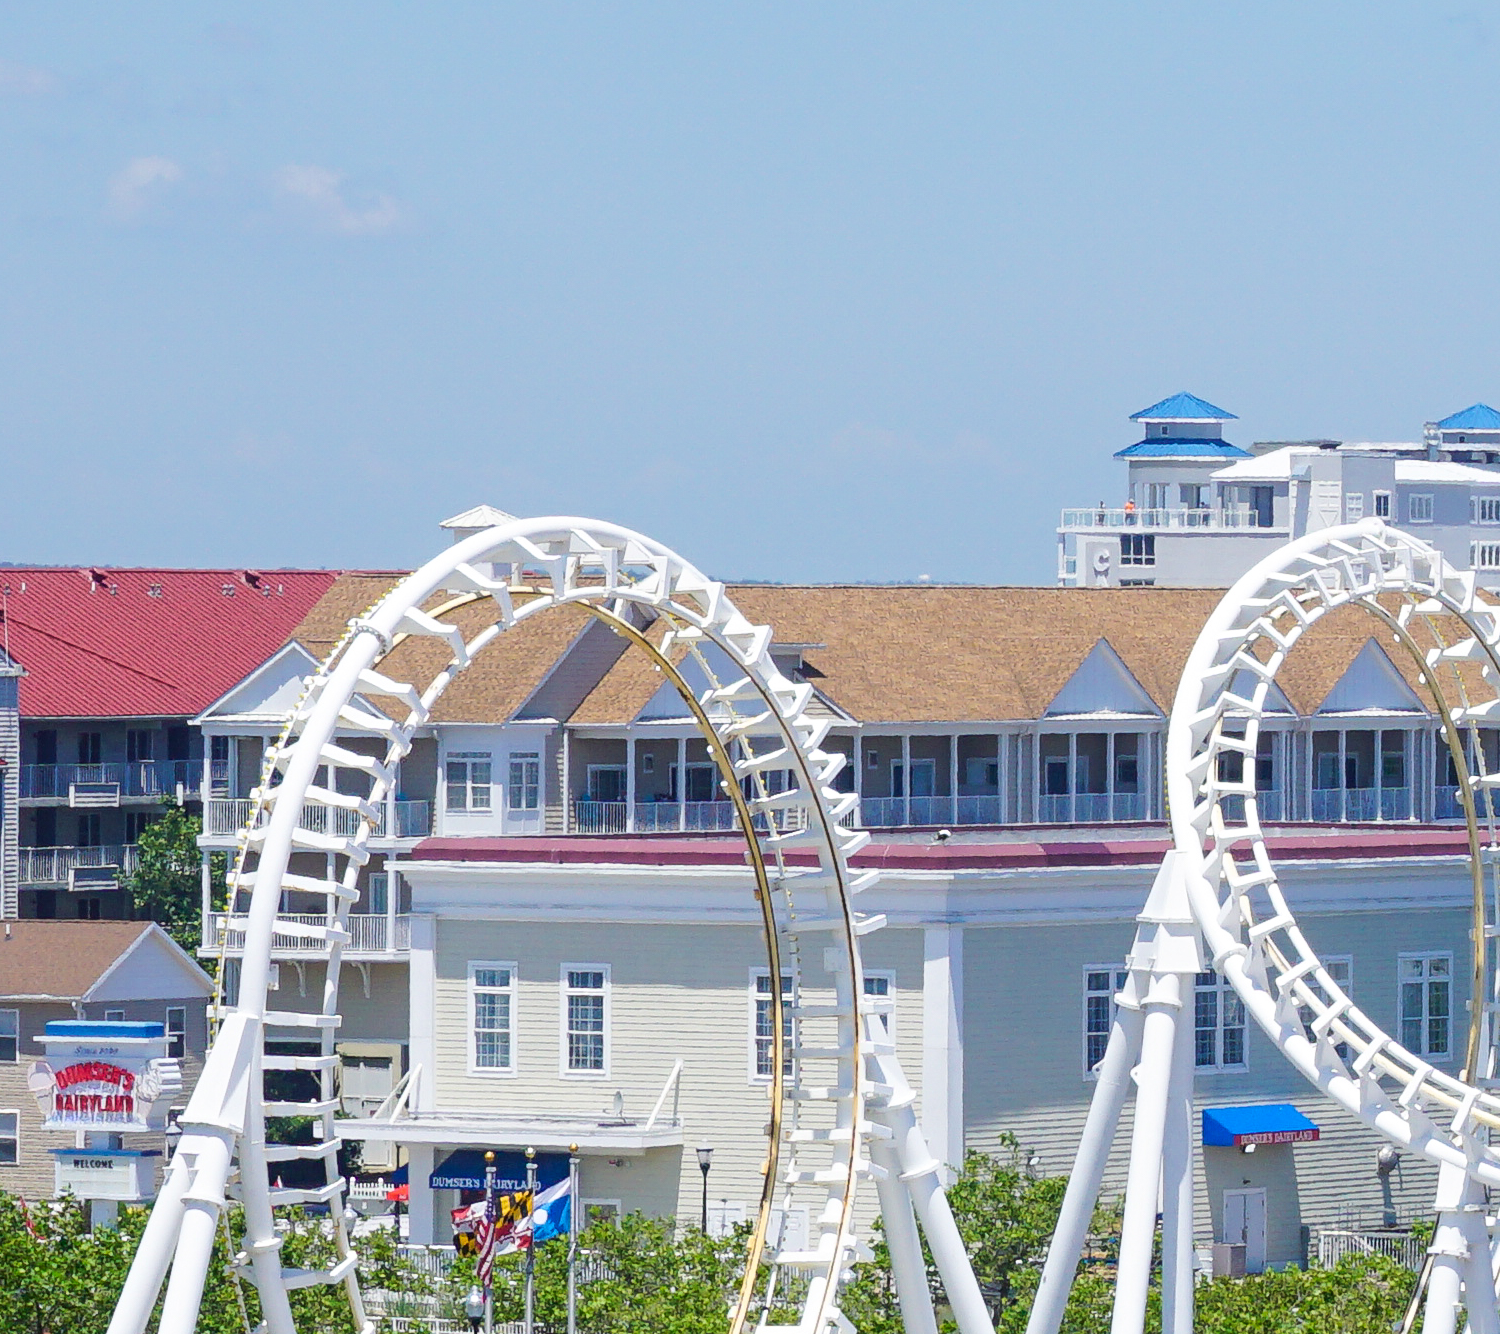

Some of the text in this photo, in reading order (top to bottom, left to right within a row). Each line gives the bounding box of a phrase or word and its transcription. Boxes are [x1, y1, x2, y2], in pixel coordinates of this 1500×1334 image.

[55, 1061, 135, 1091] DUMSER'S
[55, 1094, 134, 1113] DAIRYLAND
[73, 1159, 114, 1169] WELCOME
[432, 1176, 480, 1188] DUMSER'S
